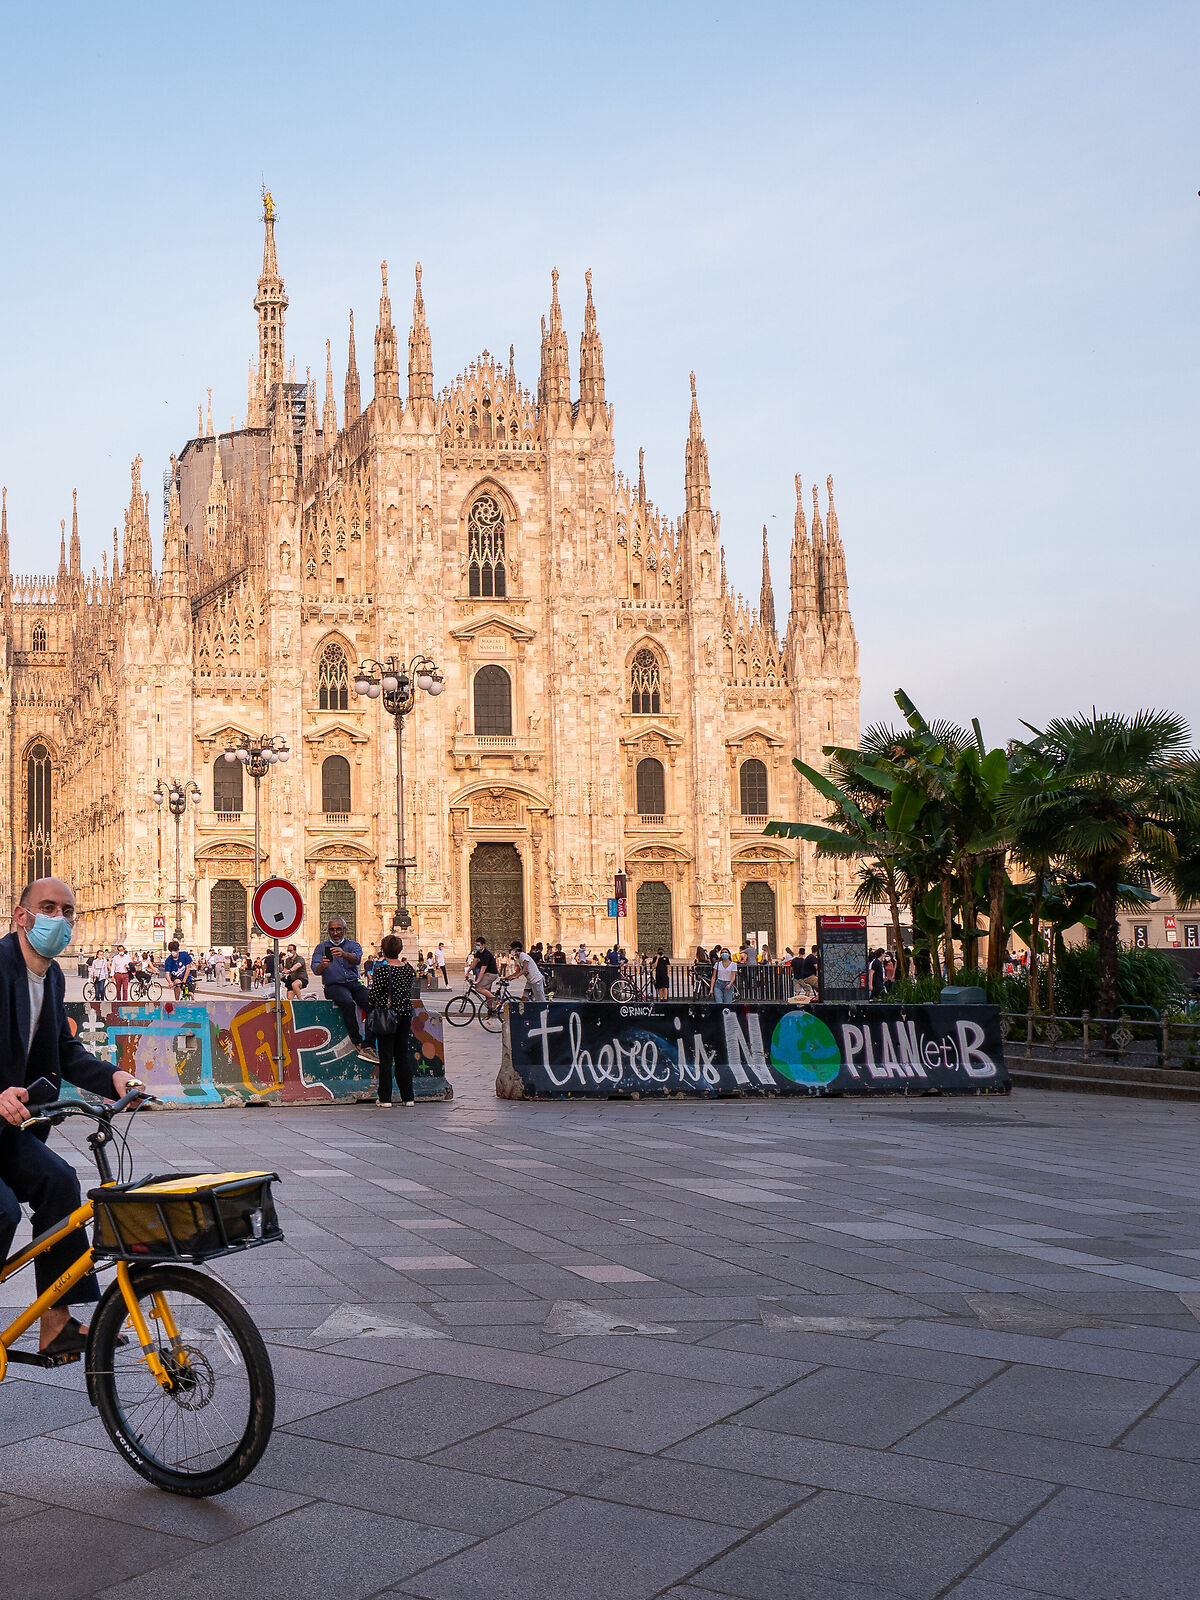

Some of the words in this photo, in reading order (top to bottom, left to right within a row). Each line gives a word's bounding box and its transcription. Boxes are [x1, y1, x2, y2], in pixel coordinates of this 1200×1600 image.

[154, 917, 164, 926] M
[1166, 919, 1175, 927] M
[527, 1009, 670, 1086] there
[673, 1016, 720, 1085] is
[956, 1020, 998, 1078] B
[115, 1430, 144, 1465] KENDA
